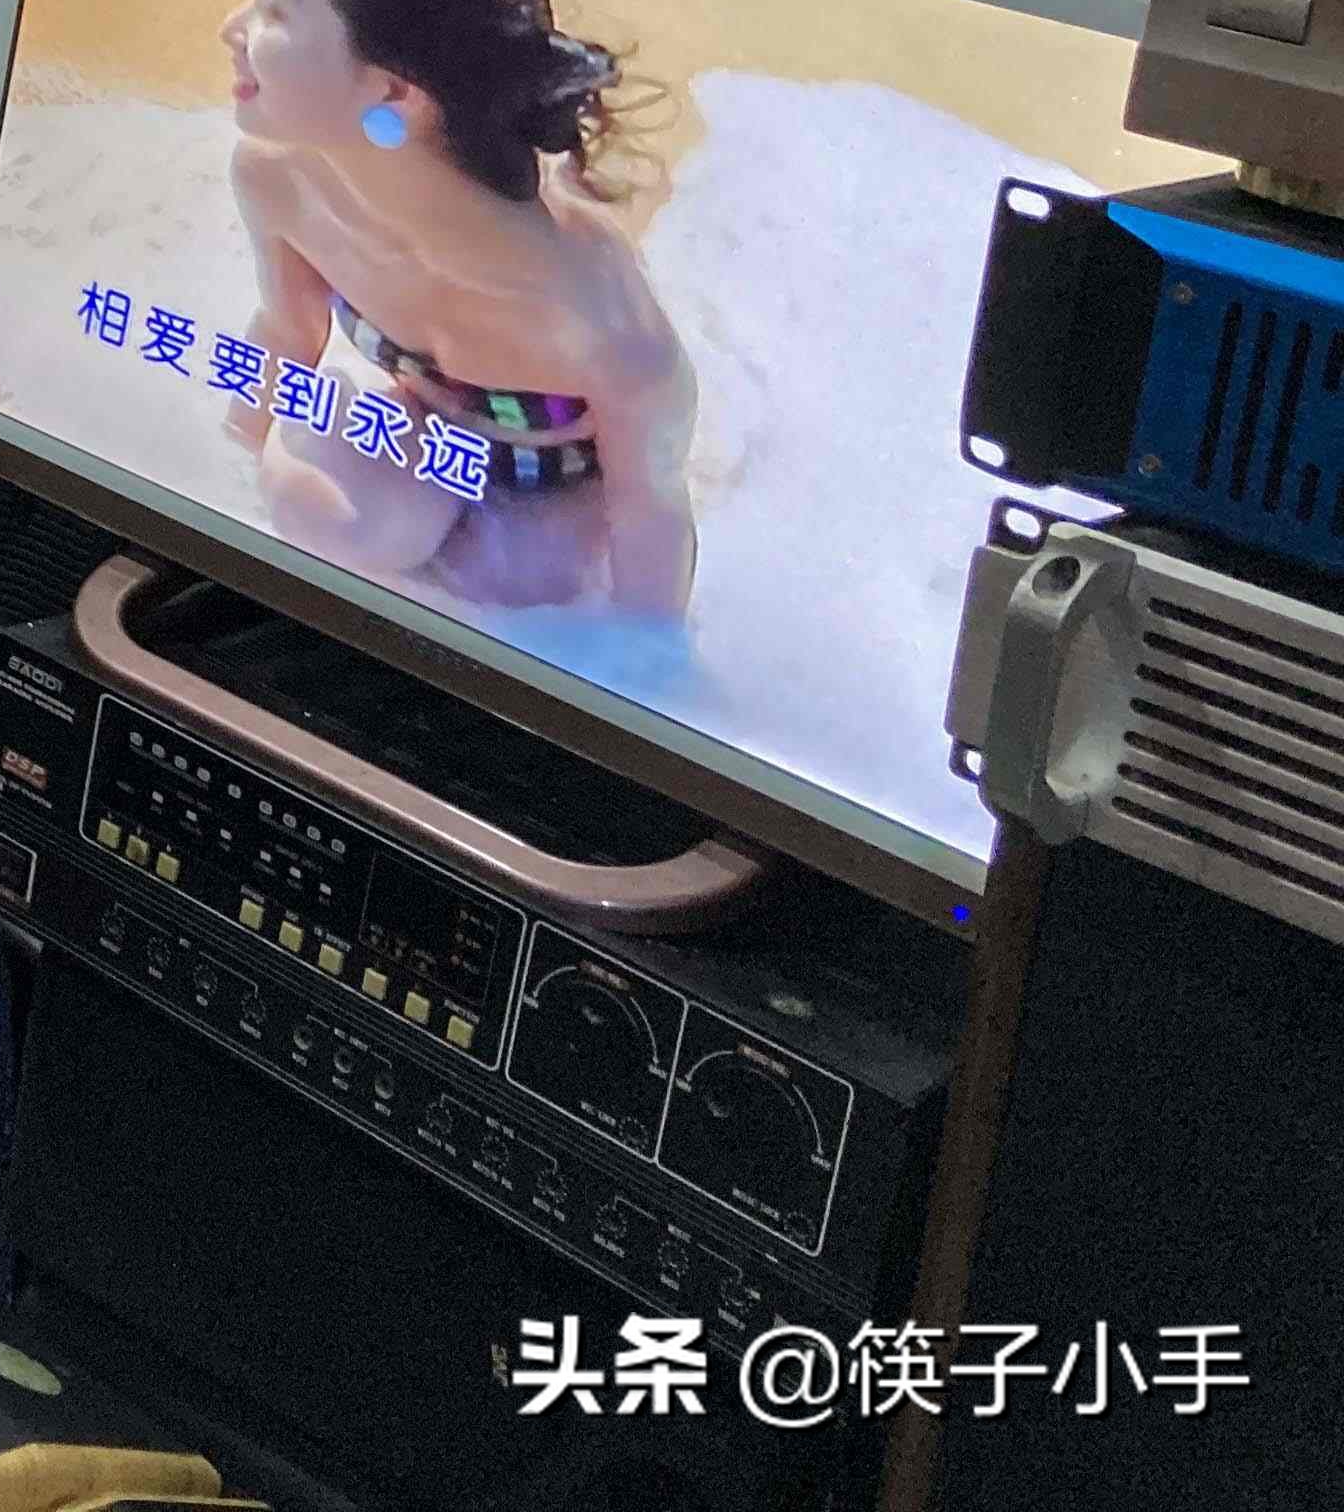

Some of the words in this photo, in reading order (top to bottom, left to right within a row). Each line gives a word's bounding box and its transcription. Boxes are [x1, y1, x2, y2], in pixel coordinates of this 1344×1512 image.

[76, 279, 491, 501] 相爱要到永远
